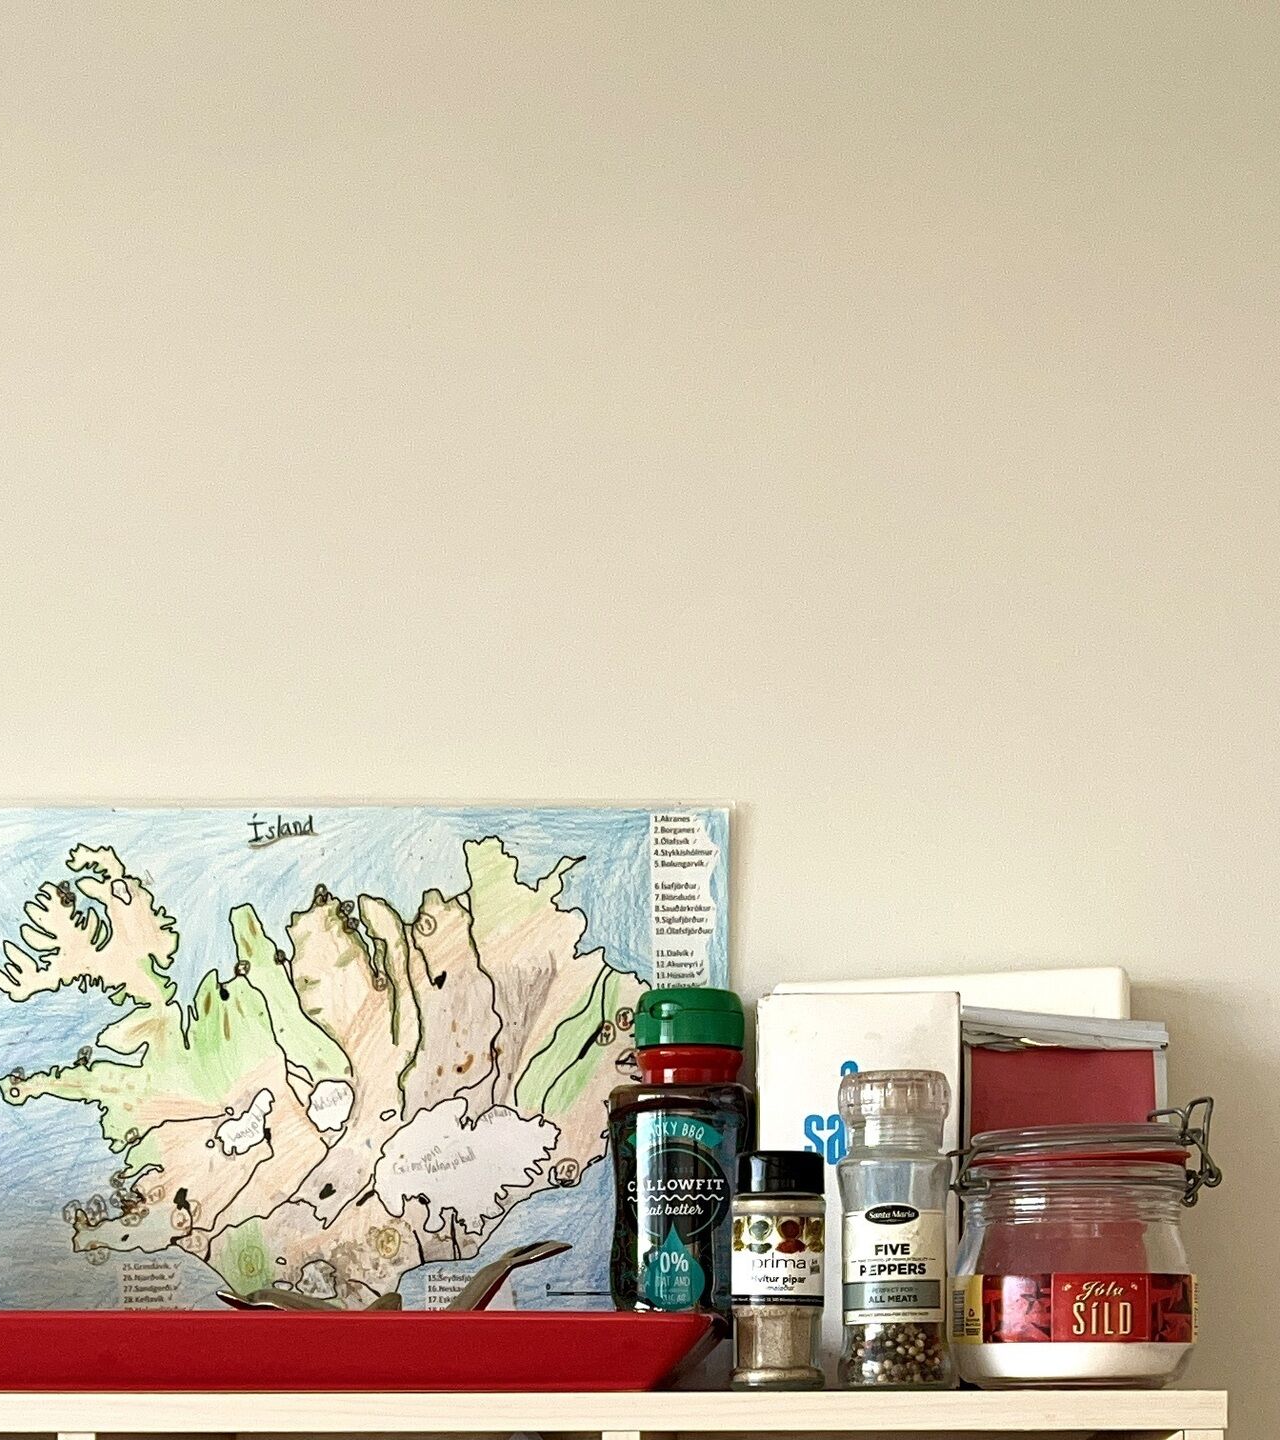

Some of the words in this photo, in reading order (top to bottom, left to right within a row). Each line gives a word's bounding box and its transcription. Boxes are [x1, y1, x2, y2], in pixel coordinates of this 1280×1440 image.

[681, 1122, 705, 1141] BBQ
[664, 1203, 705, 1217] better
[868, 1210, 891, 1220] Santa
[892, 1210, 916, 1219] Maria
[875, 1243, 911, 1256] FIVE
[751, 1252, 807, 1271] prima
[860, 1263, 927, 1276] PEPPERS
[782, 1274, 807, 1286] pipar
[869, 1294, 886, 1303] ALL
[887, 1294, 919, 1303] MEATS
